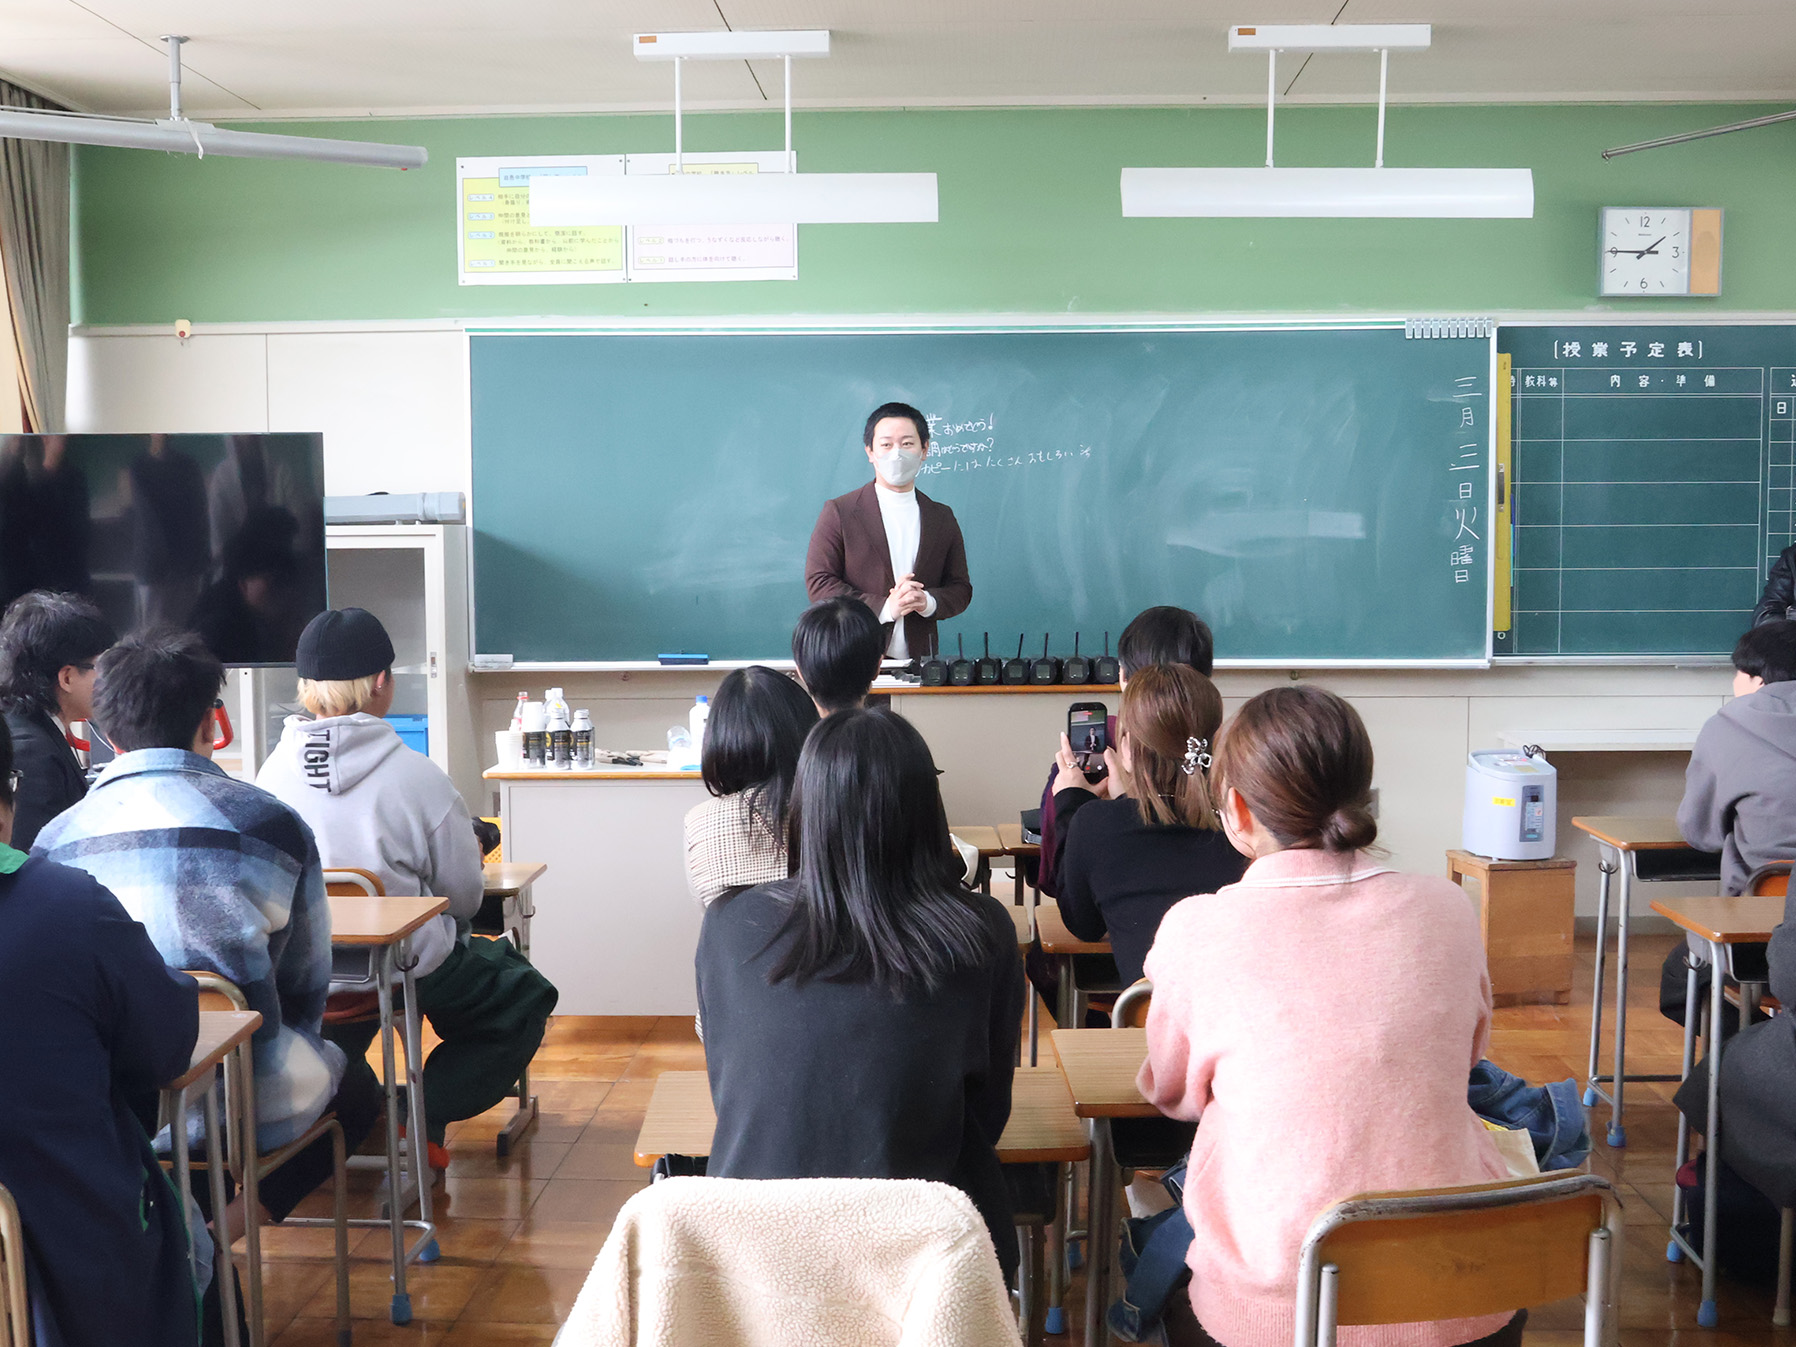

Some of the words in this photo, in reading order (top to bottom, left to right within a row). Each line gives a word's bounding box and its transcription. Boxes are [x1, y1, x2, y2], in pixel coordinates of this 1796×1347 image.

[1640, 216, 1650, 228] 12
[1610, 246, 1618, 258] 9
[1672, 246, 1680, 259] 3
[1640, 277, 1648, 289] 6
[1776, 402, 1787, 415] 日
[304, 729, 332, 793] TIGHT
